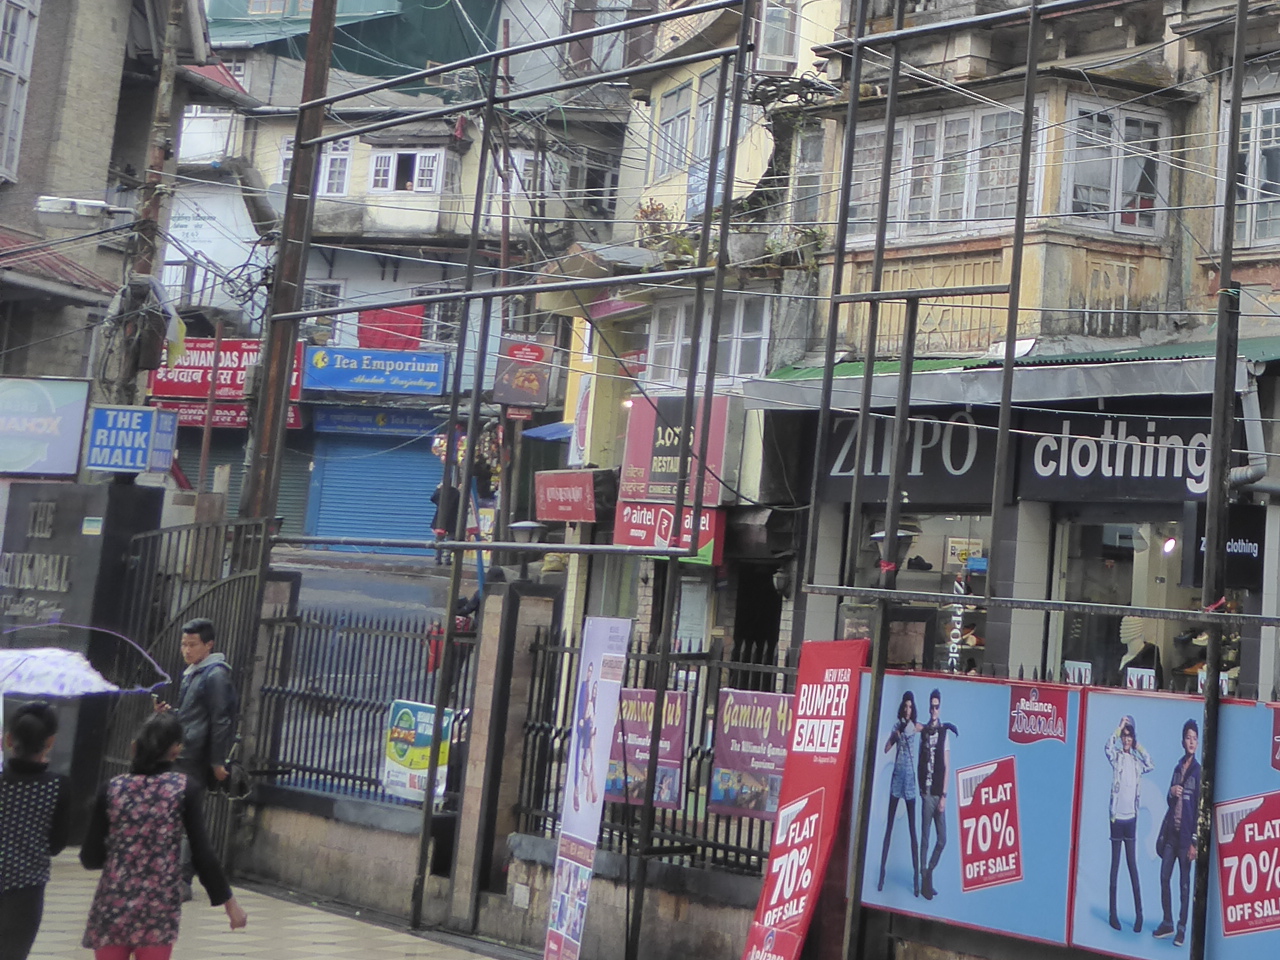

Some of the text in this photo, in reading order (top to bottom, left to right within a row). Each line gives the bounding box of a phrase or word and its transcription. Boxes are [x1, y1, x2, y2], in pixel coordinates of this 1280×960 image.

[334, 354, 439, 374] Tea Emporium
[106, 410, 141, 428] THE
[96, 429, 148, 448] RINK
[829, 411, 978, 476] ZIPPO
[91, 447, 146, 467] MALL
[1033, 420, 1213, 493] clothing
[631, 505, 655, 526] airtel
[684, 510, 710, 530] aiel
[630, 528, 646, 539] money
[1226, 538, 1258, 557] clothing
[823, 668, 851, 682] NEW YEAR
[797, 684, 850, 716] BUMPER
[1020, 698, 1052, 712] Reliance
[723, 692, 772, 739] Gaming
[1011, 701, 1065, 738] trends
[792, 719, 844, 752] SALE
[981, 782, 1013, 805] FLAT
[788, 813, 819, 847] FLAT
[963, 808, 1015, 855] 70%
[769, 843, 812, 906] 70%
[966, 860, 987, 879] OFF
[988, 853, 1016, 874] SALE
[764, 896, 806, 927] OFF SALE
[1227, 903, 1252, 922] OFF
